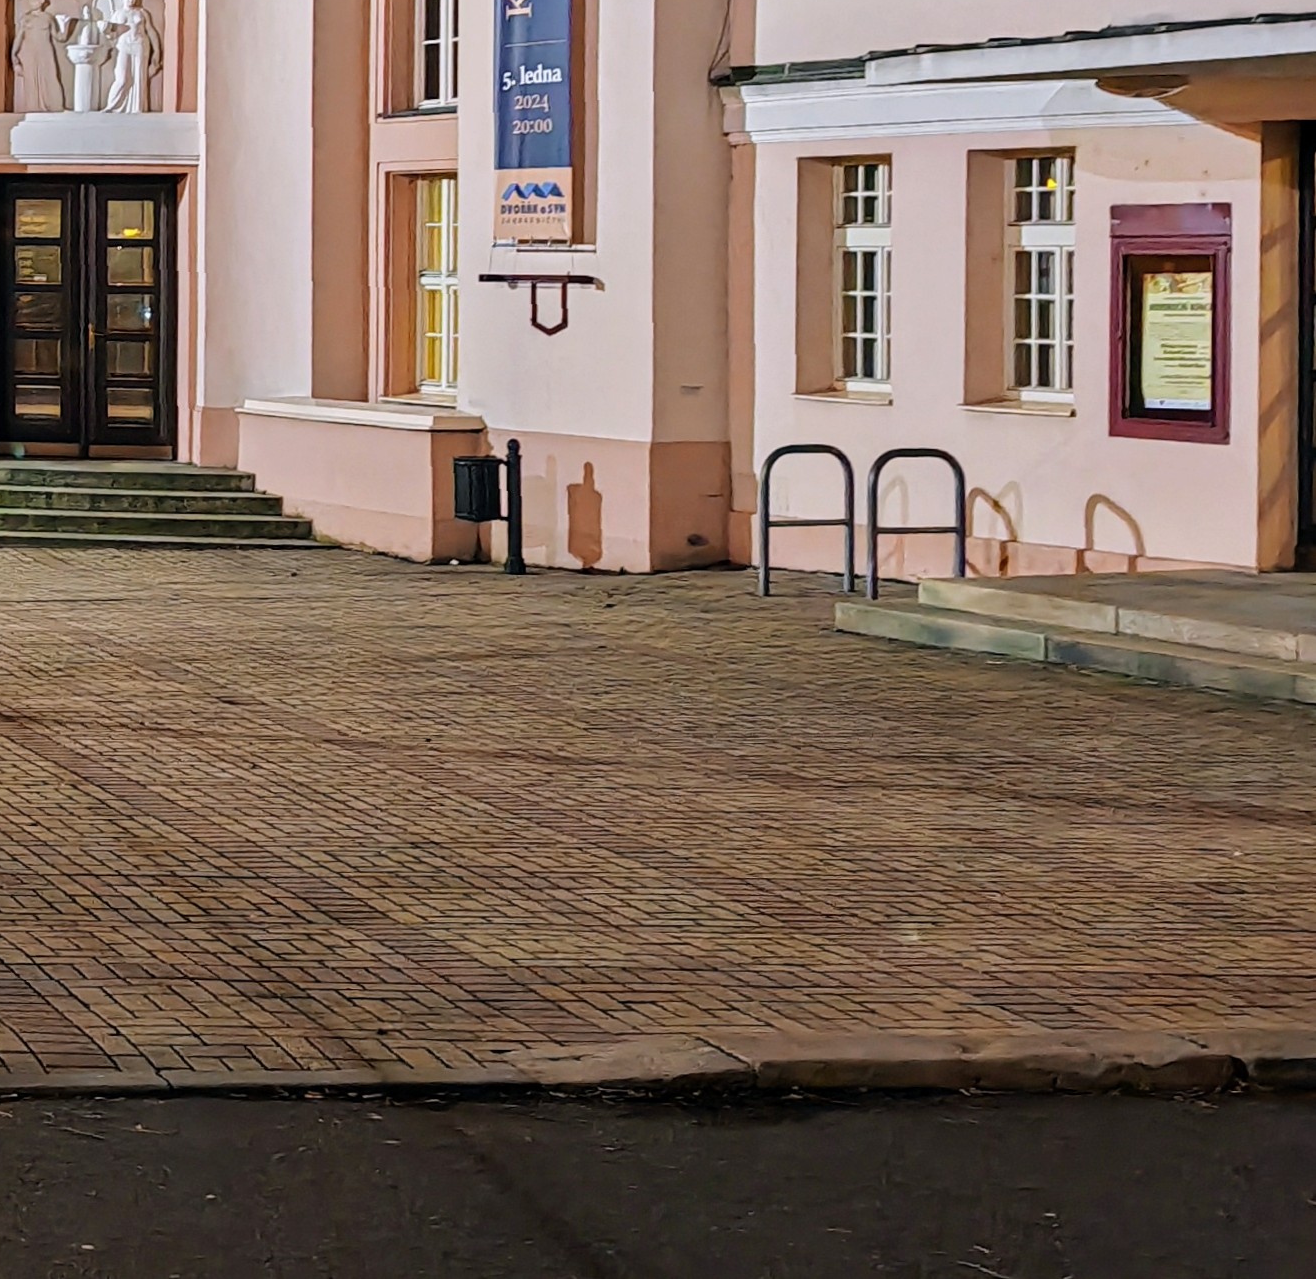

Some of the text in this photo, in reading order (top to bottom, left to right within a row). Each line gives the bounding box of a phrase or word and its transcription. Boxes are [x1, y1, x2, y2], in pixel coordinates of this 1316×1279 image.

[502, 63, 563, 91] 5. ledna
[514, 94, 549, 113] 2024
[512, 118, 553, 135] 20:00
